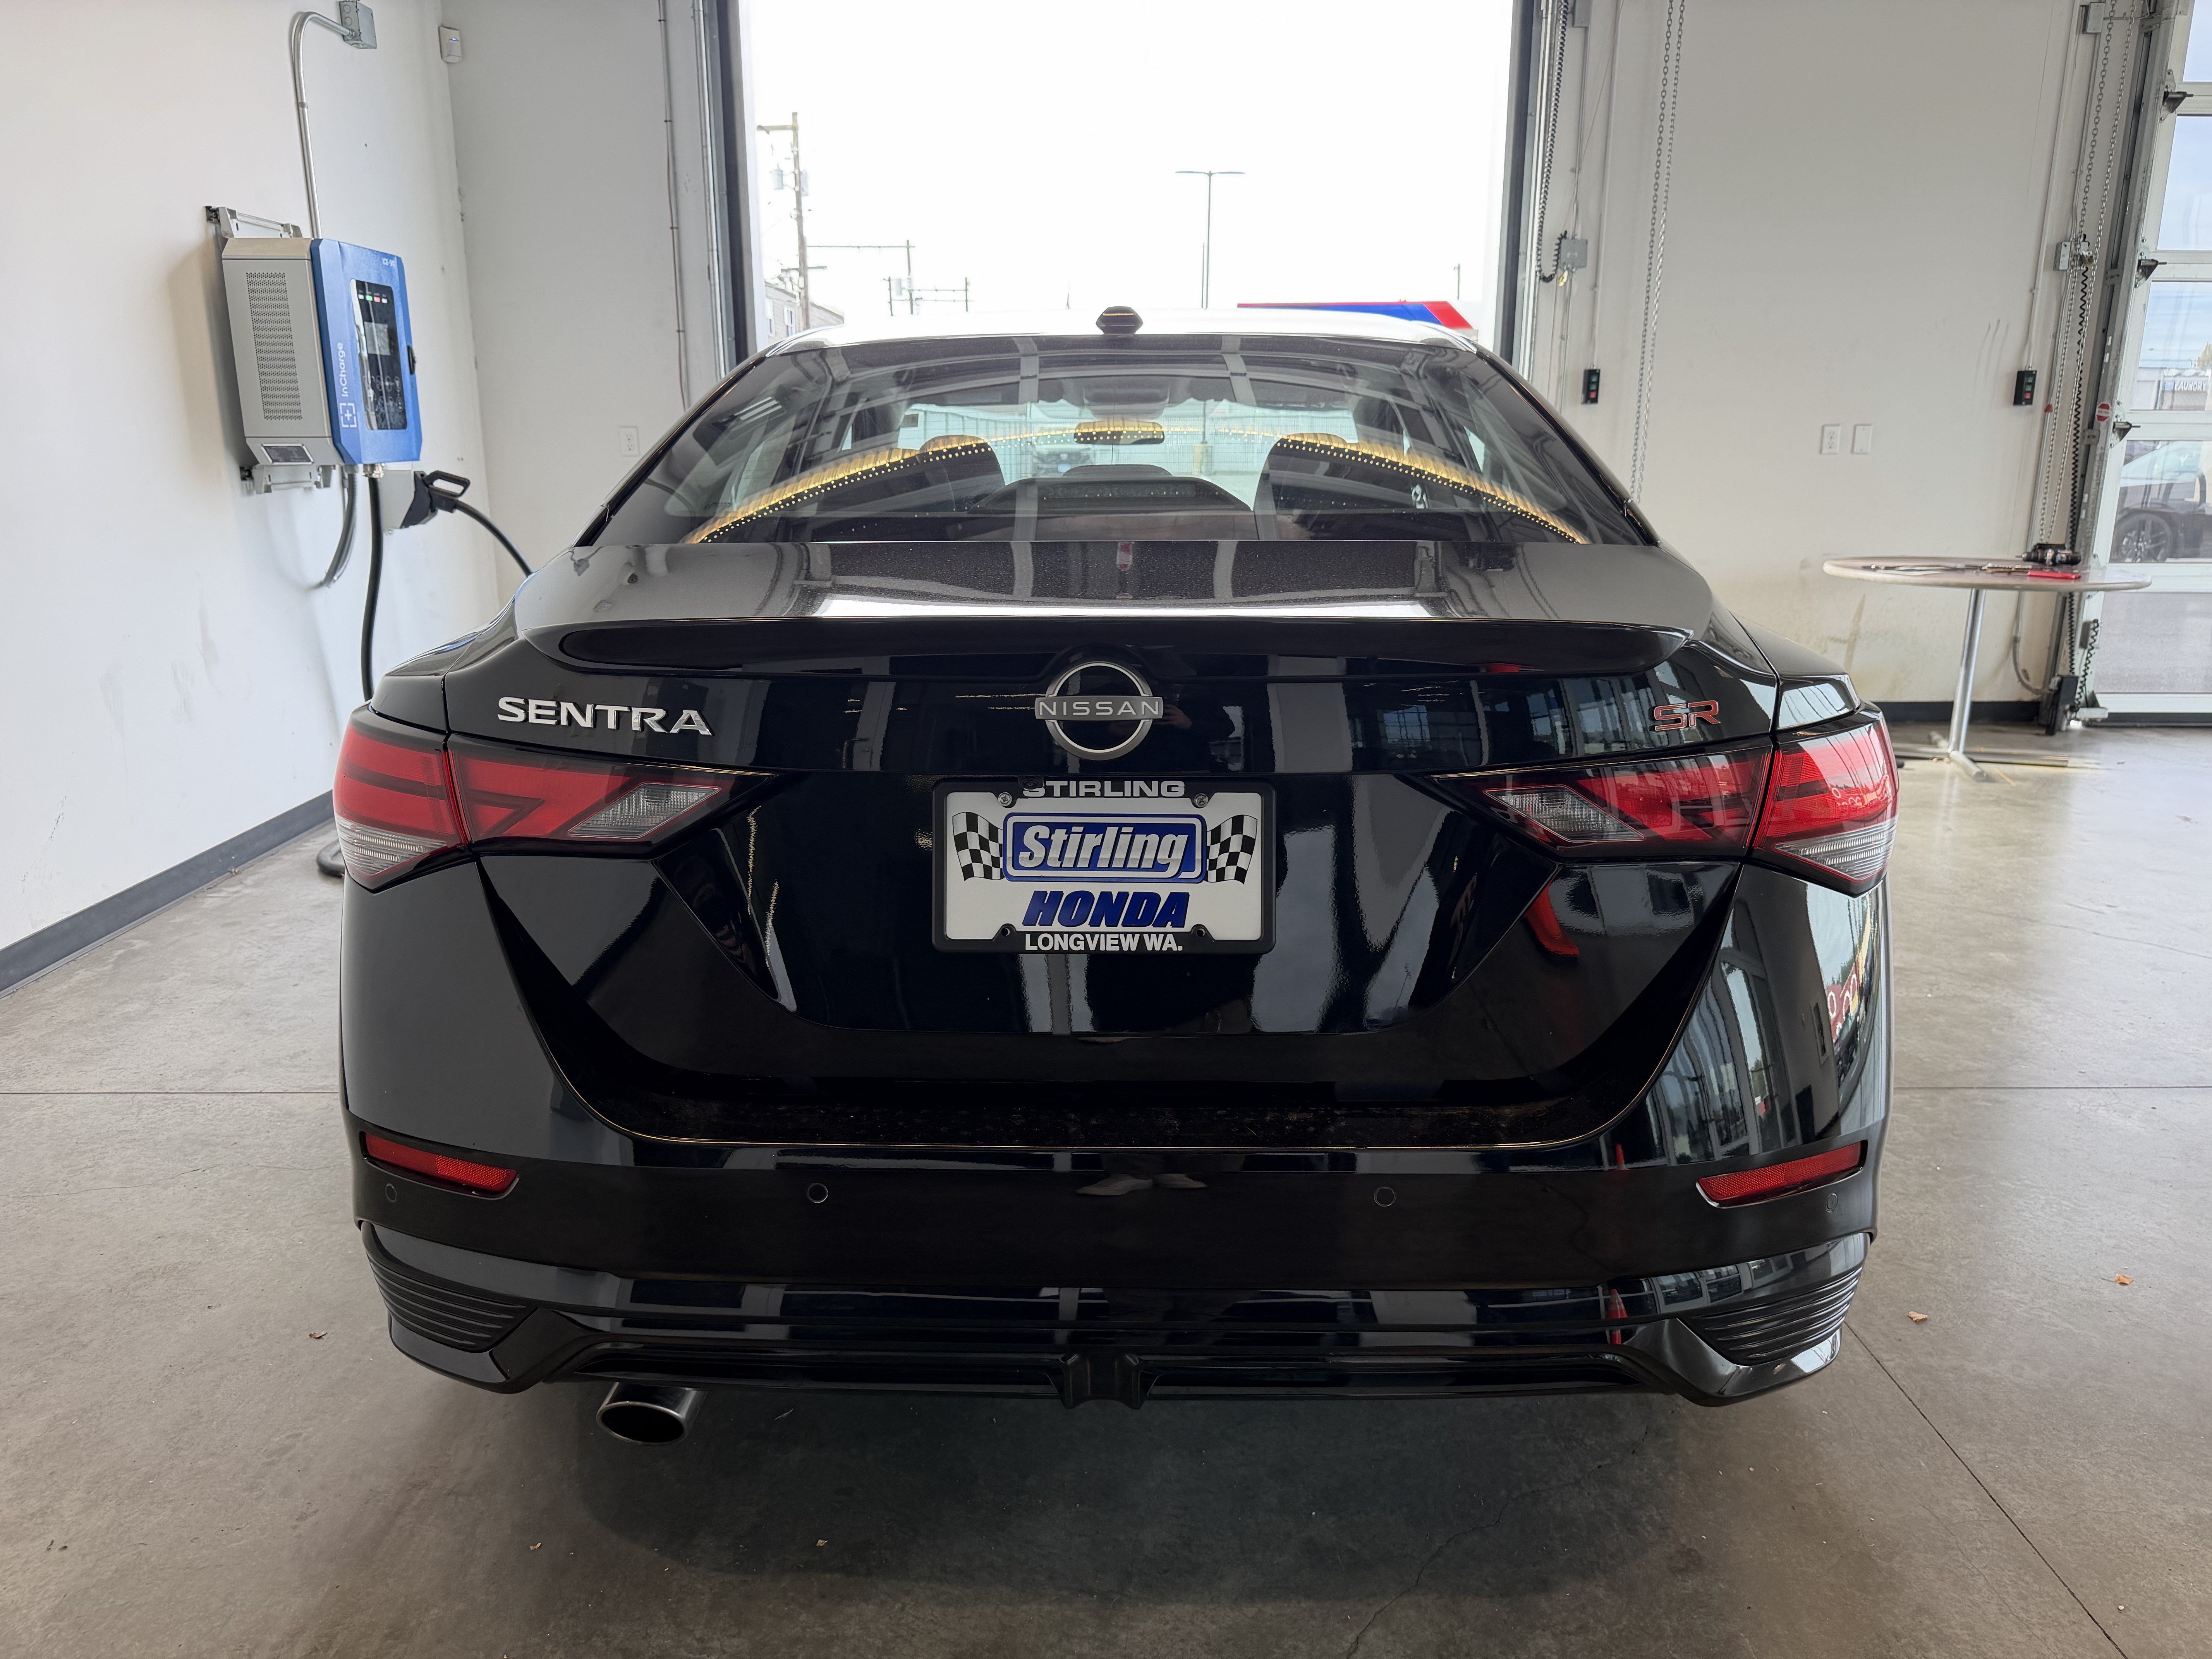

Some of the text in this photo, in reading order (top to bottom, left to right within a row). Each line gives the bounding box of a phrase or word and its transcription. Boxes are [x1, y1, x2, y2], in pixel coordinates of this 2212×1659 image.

[337, 342, 349, 397] InCharge
[2174, 380, 2207, 391] LAUNDRY
[497, 697, 713, 736] SENTRA
[1039, 701, 1159, 716] NISSAN
[1654, 700, 1721, 731] SR
[1018, 824, 1189, 878] Stirling
[1022, 890, 1190, 928] HONDA
[1025, 933, 1183, 951] LONGVIEW WA.
